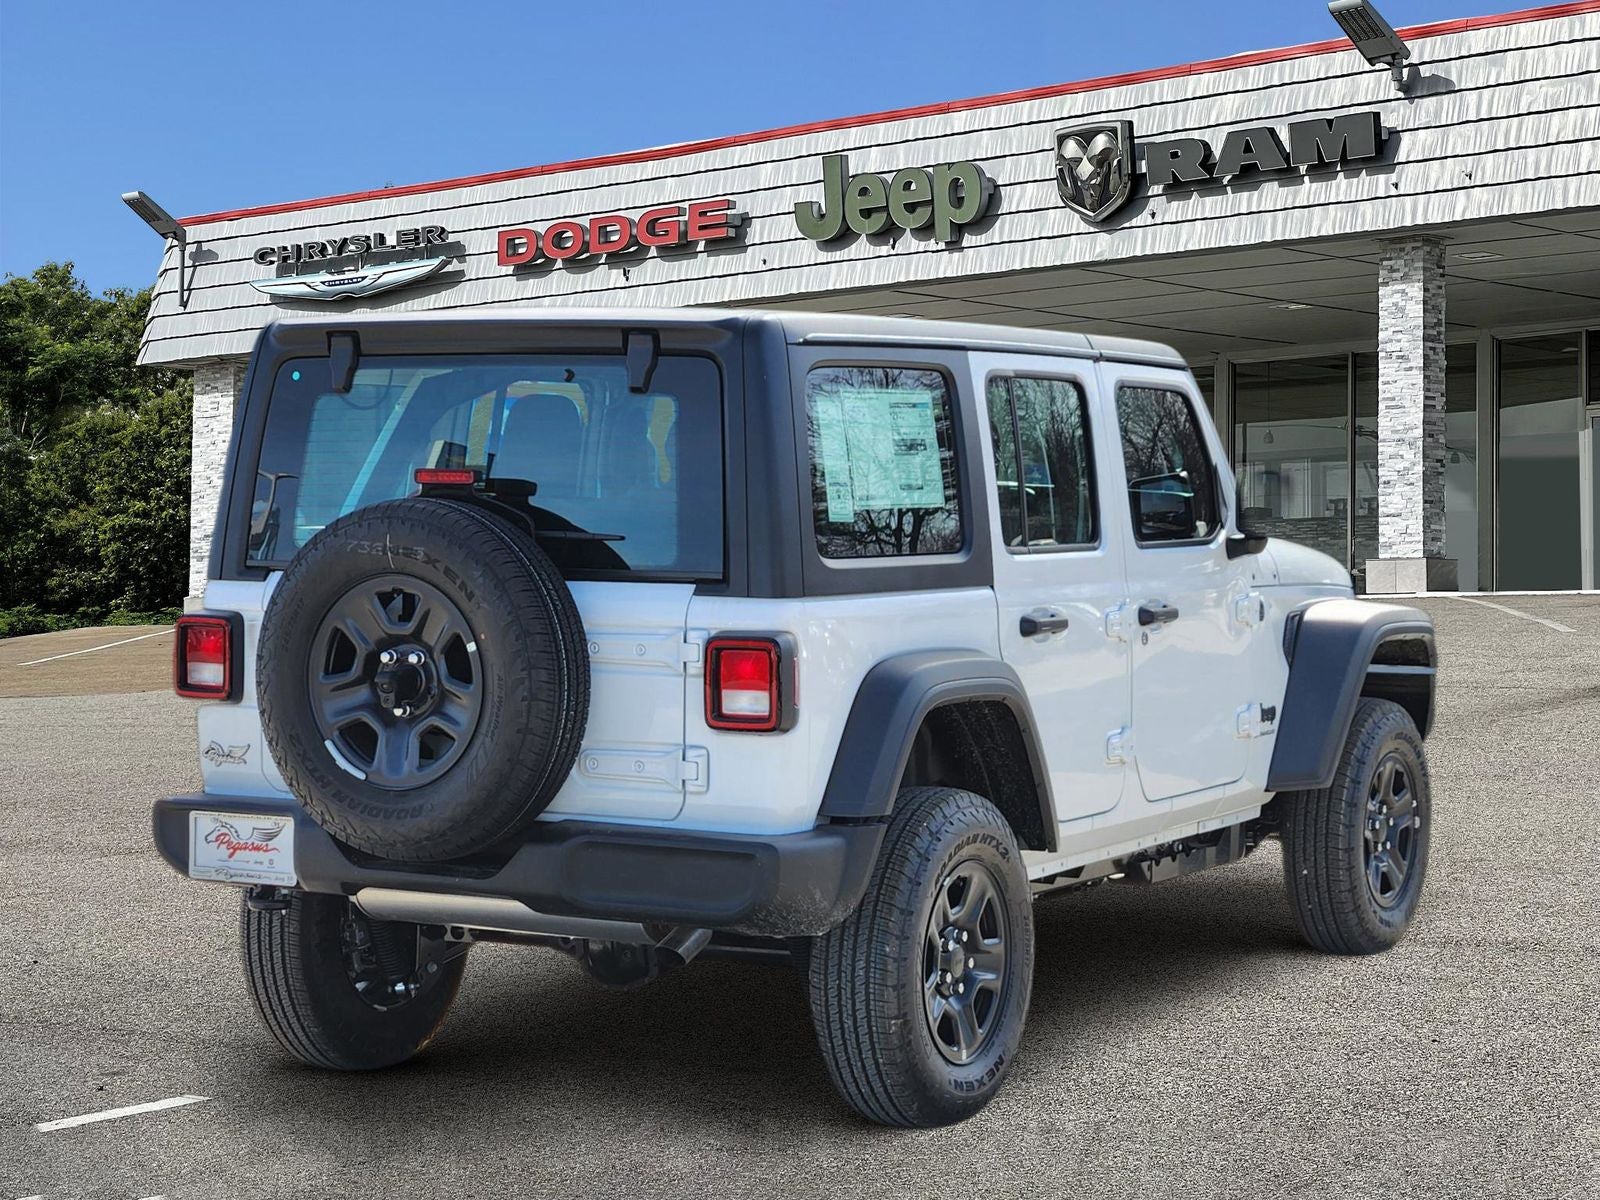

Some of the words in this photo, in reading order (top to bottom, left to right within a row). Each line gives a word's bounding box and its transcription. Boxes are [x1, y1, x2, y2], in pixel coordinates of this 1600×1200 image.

[1145, 111, 1382, 186] RAM
[794, 154, 986, 242] Jeep
[253, 225, 448, 266] CHRYSLER
[497, 199, 735, 266] DODGE
[324, 278, 363, 286] CHRYSLER
[215, 832, 280, 859] Pegasus
[953, 1054, 1005, 1092] NEXEN
